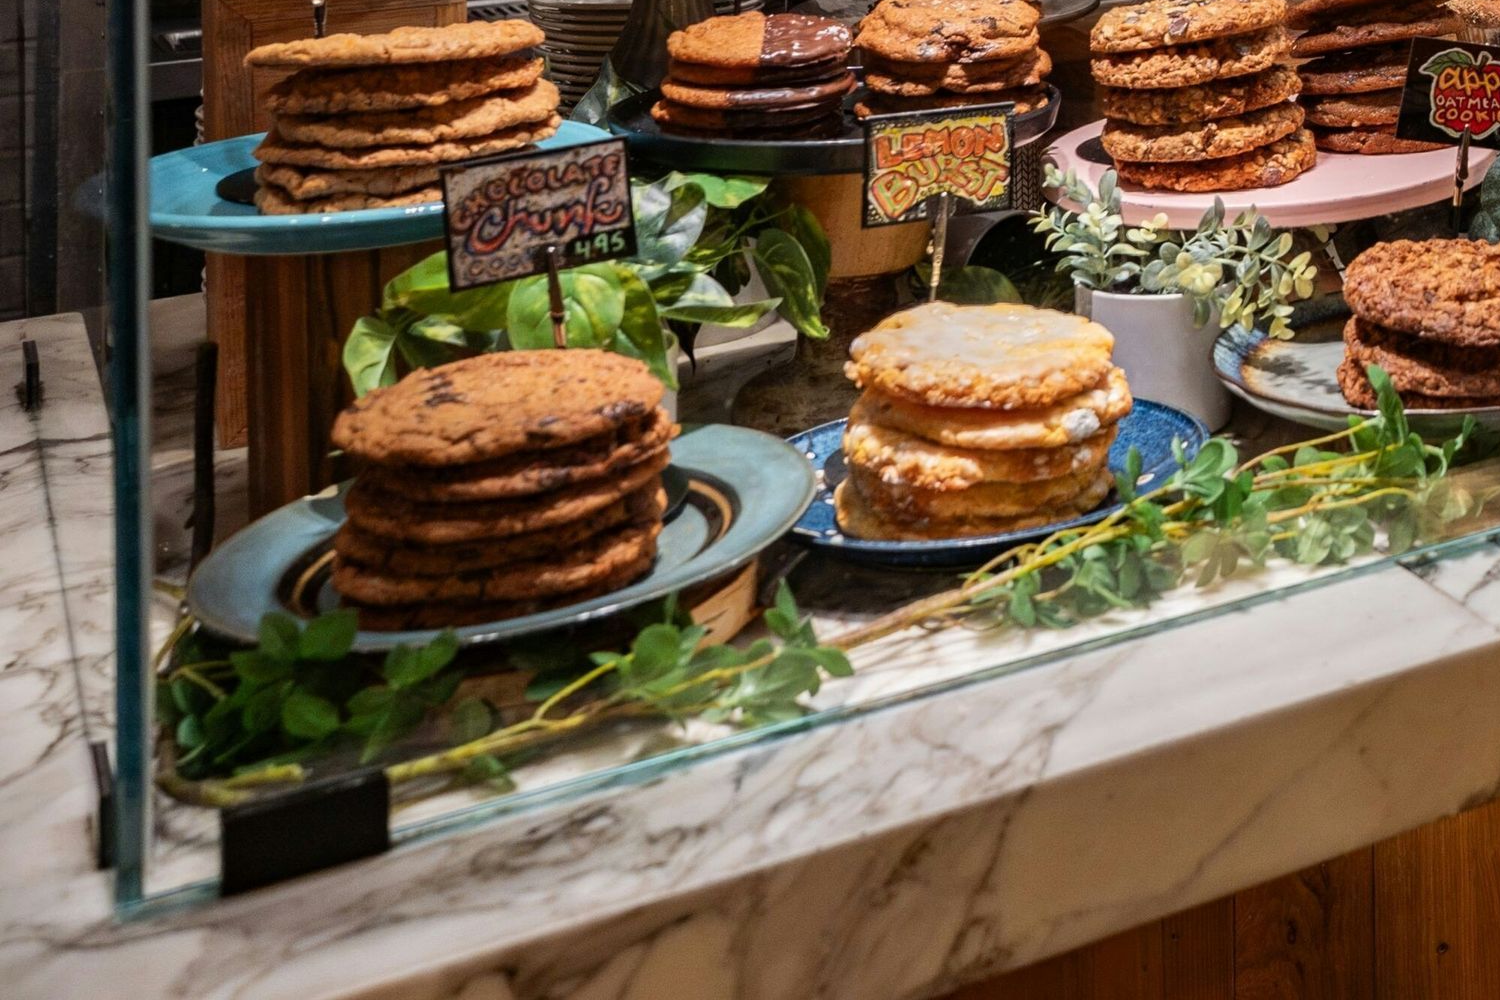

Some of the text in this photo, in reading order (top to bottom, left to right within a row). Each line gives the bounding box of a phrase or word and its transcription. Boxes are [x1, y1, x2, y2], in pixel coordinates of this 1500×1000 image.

[875, 122, 1006, 170] LEMON
[451, 153, 621, 234] CHOCOLATE
[464, 176, 624, 256] Chunk
[871, 156, 1011, 219] BURST
